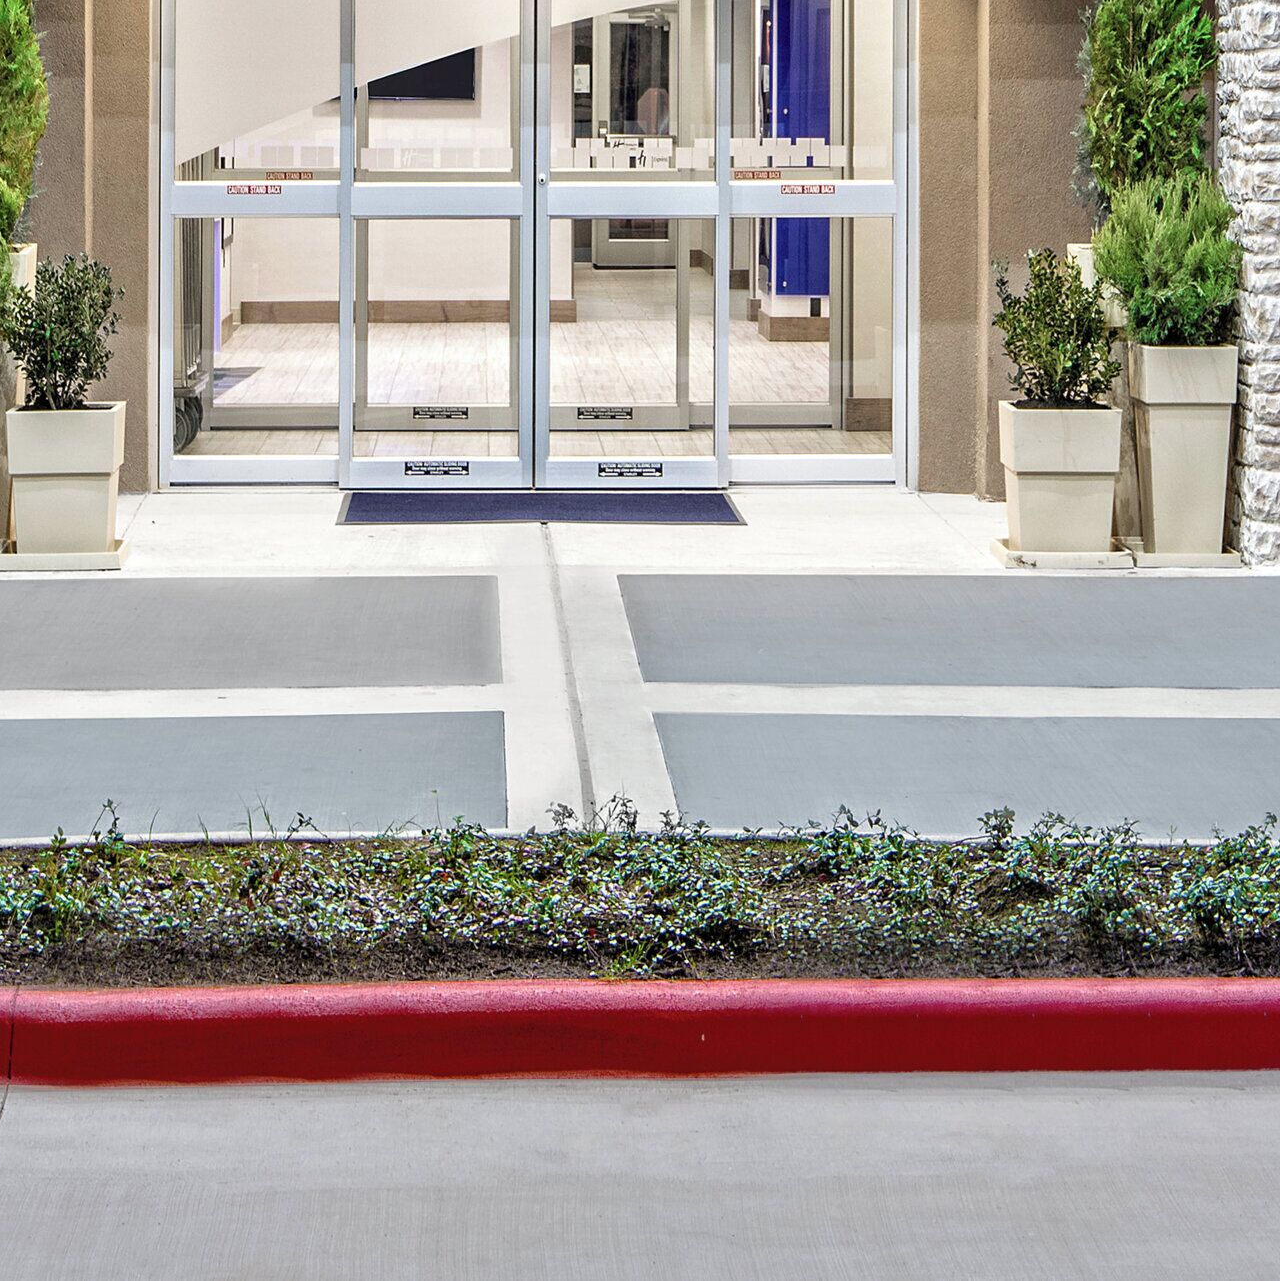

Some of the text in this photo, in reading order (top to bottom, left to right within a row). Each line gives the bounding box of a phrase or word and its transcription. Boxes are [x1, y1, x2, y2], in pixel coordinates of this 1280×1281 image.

[735, 171, 780, 179] CAUTION STAND BACK
[228, 185, 280, 194] CAUTION STAND BACK
[782, 185, 834, 194] CAUTION STAND BACK
